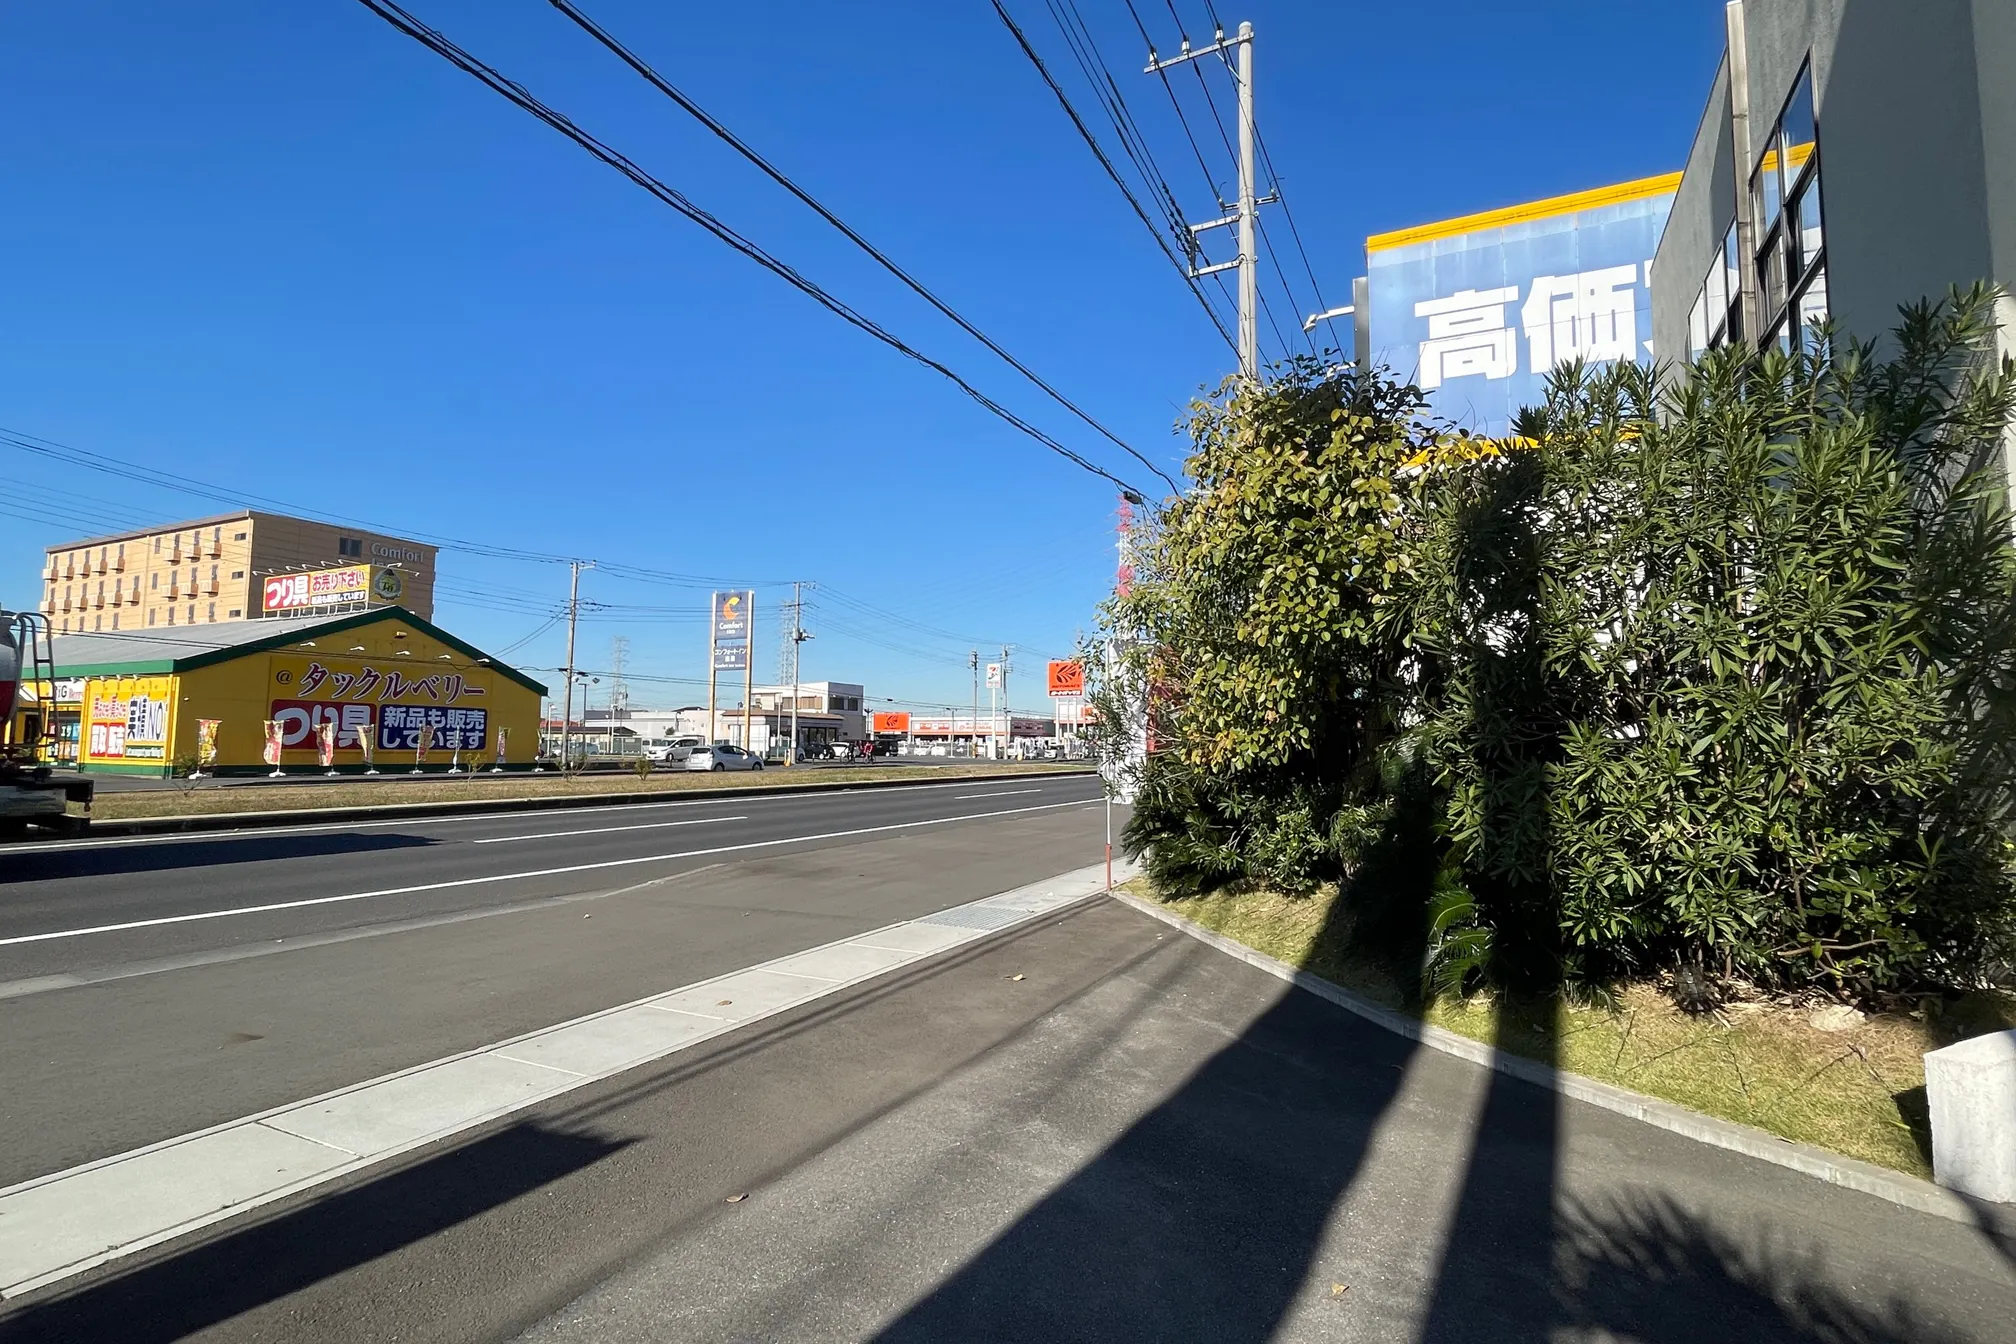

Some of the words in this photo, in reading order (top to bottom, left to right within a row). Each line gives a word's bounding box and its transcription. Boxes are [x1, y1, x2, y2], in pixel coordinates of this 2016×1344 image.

[1414, 259, 1653, 389] 高価
[371, 542, 425, 563] Comfort
[266, 575, 309, 607] つり具
[312, 570, 365, 592] お売り下さい
[719, 621, 744, 630] Comfort
[297, 662, 486, 704] タックルベリー
[274, 704, 371, 746] つり具
[384, 706, 486, 730] 新品も販売
[382, 728, 484, 749] しています
